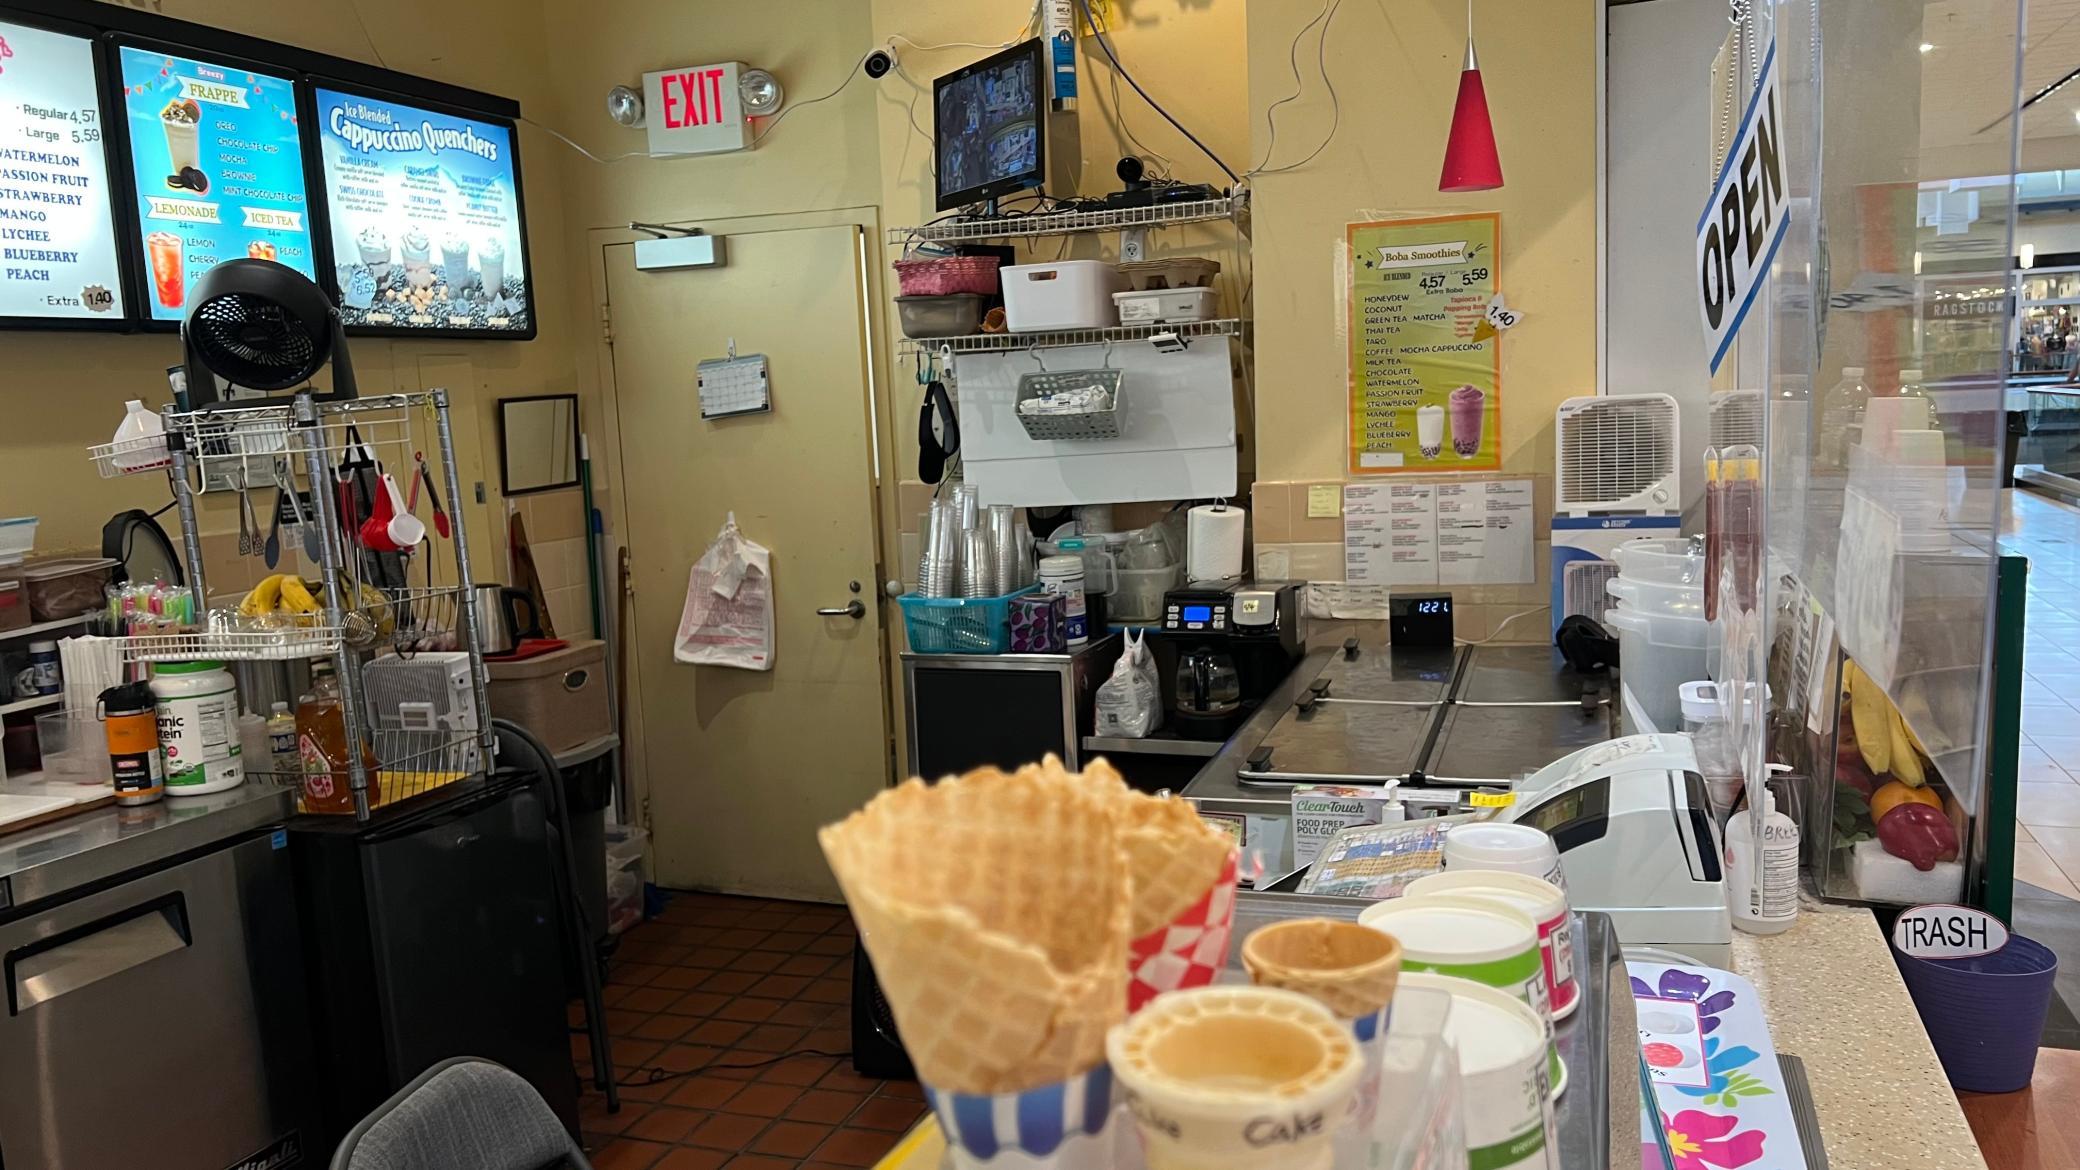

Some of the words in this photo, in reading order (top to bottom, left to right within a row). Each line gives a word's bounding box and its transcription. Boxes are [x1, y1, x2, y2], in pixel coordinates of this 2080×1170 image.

[189, 83, 239, 104] FRAPPE
[661, 69, 724, 129] EXIT
[23, 104, 69, 120] Regular
[70, 110, 96, 125] 4.57
[344, 101, 357, 118] Ice
[358, 104, 391, 125] Blended
[26, 127, 60, 143] Large
[71, 129, 100, 143] 5.59
[329, 106, 423, 153] Cappuccino
[421, 120, 498, 161] Quenchers
[217, 137, 260, 151] CHOCOLATE
[0, 149, 80, 167] ATERMELON
[219, 153, 247, 163] MOCHA
[0, 169, 48, 183] ASSION
[52, 174, 89, 188] FRUIT
[243, 188, 285, 200] CHOCOLATE
[154, 202, 217, 218] LEMONADE
[1702, 84, 1782, 331] OPEN
[0, 208, 47, 222] MANGO
[251, 212, 274, 225] ICED
[275, 215, 294, 226] TEA
[2, 228, 51, 242] LYCHEE
[187, 238, 216, 248] LEMON
[4, 248, 79, 263] BLUEBERRY
[279, 247, 303, 256] PEACH
[1385, 252, 1409, 261] Boba
[1411, 248, 1461, 260] Smoothies
[189, 255, 220, 265] CHERRY
[6, 268, 50, 281] PEACH
[1462, 267, 1488, 286] 5.59
[1419, 275, 1446, 289] 4.57
[47, 295, 79, 306] Extra
[1364, 294, 1410, 303] HONEYDEW
[1364, 305, 1402, 314] COCONUT
[1934, 301, 2005, 316] RAGSTOCK
[1365, 316, 1391, 325] GREEN
[1413, 313, 1446, 321] MATCHA
[1490, 306, 1515, 326] 1.40
[1400, 346, 1430, 354] MOCHA
[1431, 343, 1483, 353] CAPPUCCINO
[1366, 368, 1413, 377] CHOCOLATE
[1366, 378, 1420, 387] WATERMELON
[1366, 390, 1400, 398] PASSION
[1401, 388, 1424, 396] FRUIT
[1366, 400, 1418, 409] STRAWBERRY
[1366, 421, 1393, 429] LYCHEE
[1366, 431, 1411, 439] BLUEBERRY
[158, 717, 184, 727] anic
[159, 727, 181, 739] tein
[1296, 800, 1365, 813] ClearTouch
[1296, 819, 1320, 827] FOOD
[1322, 820, 1345, 828] PREP
[1320, 827, 1337, 835] GLO
[1901, 916, 1987, 950] TRASH
[1244, 1112, 1324, 1149] Cake
